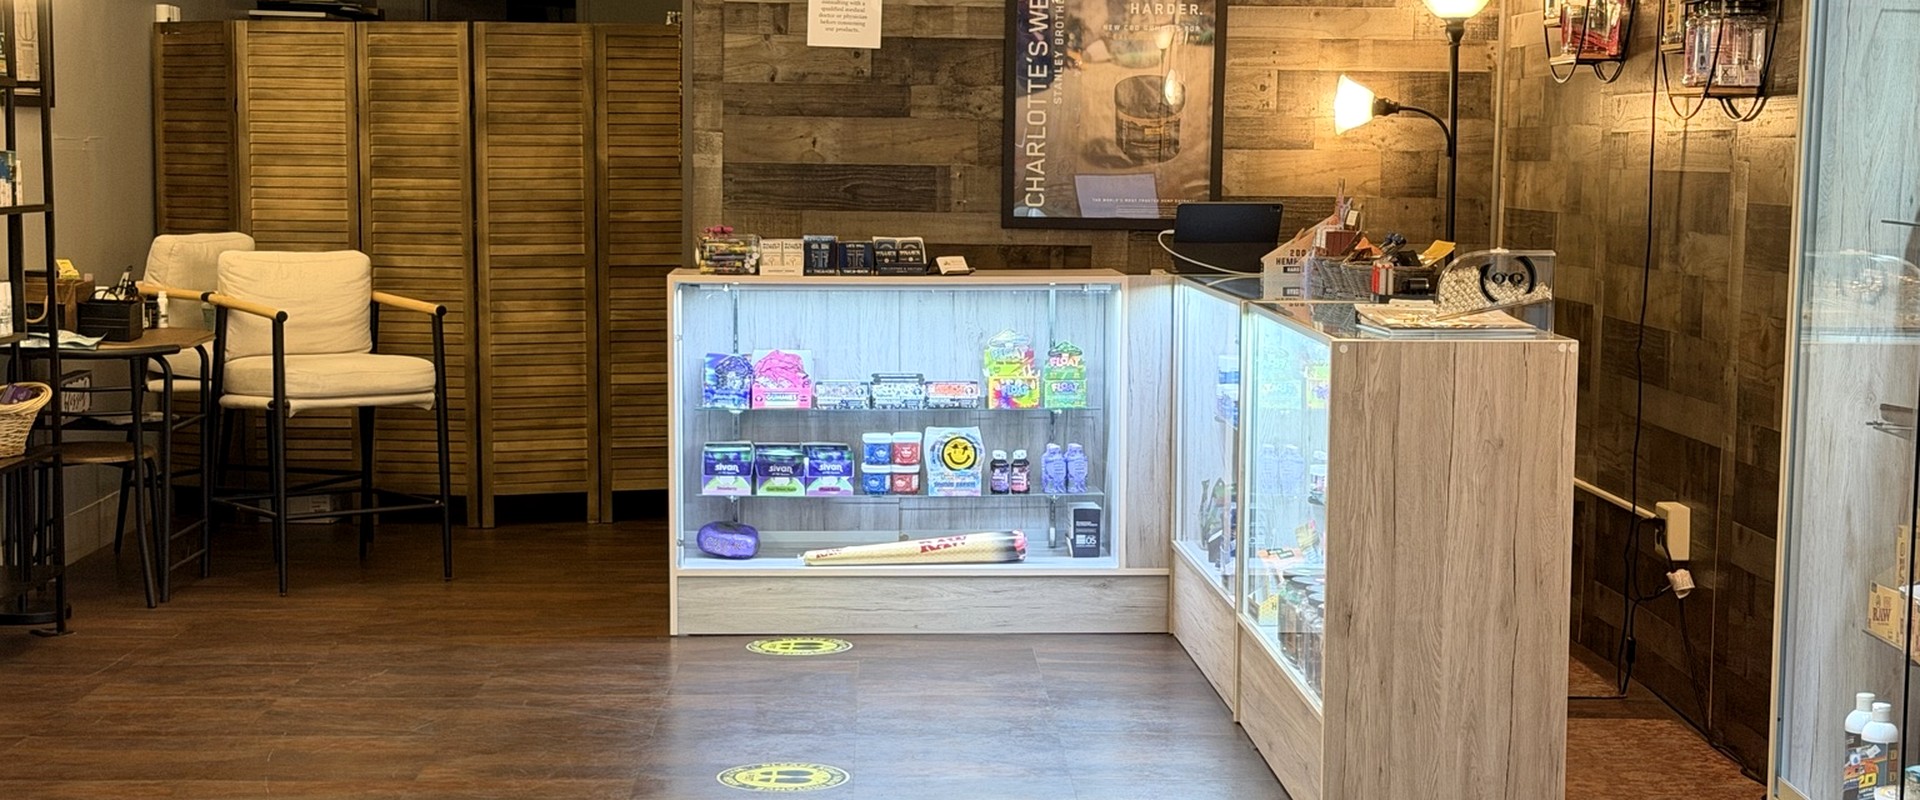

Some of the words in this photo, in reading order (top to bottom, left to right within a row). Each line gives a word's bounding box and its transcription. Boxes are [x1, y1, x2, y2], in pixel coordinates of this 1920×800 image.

[1130, 3, 1203, 16] HARDER.
[1053, 52, 1064, 105] STANLEY
[1025, 41, 1048, 207] CHARLOTTE'S
[1049, 354, 1080, 367] FLOAT
[1051, 381, 1080, 393] FLOAT
[714, 462, 740, 473] sivan
[768, 464, 794, 474] sivan
[818, 462, 844, 473] sivan
[1872, 607, 1891, 622] RAW
